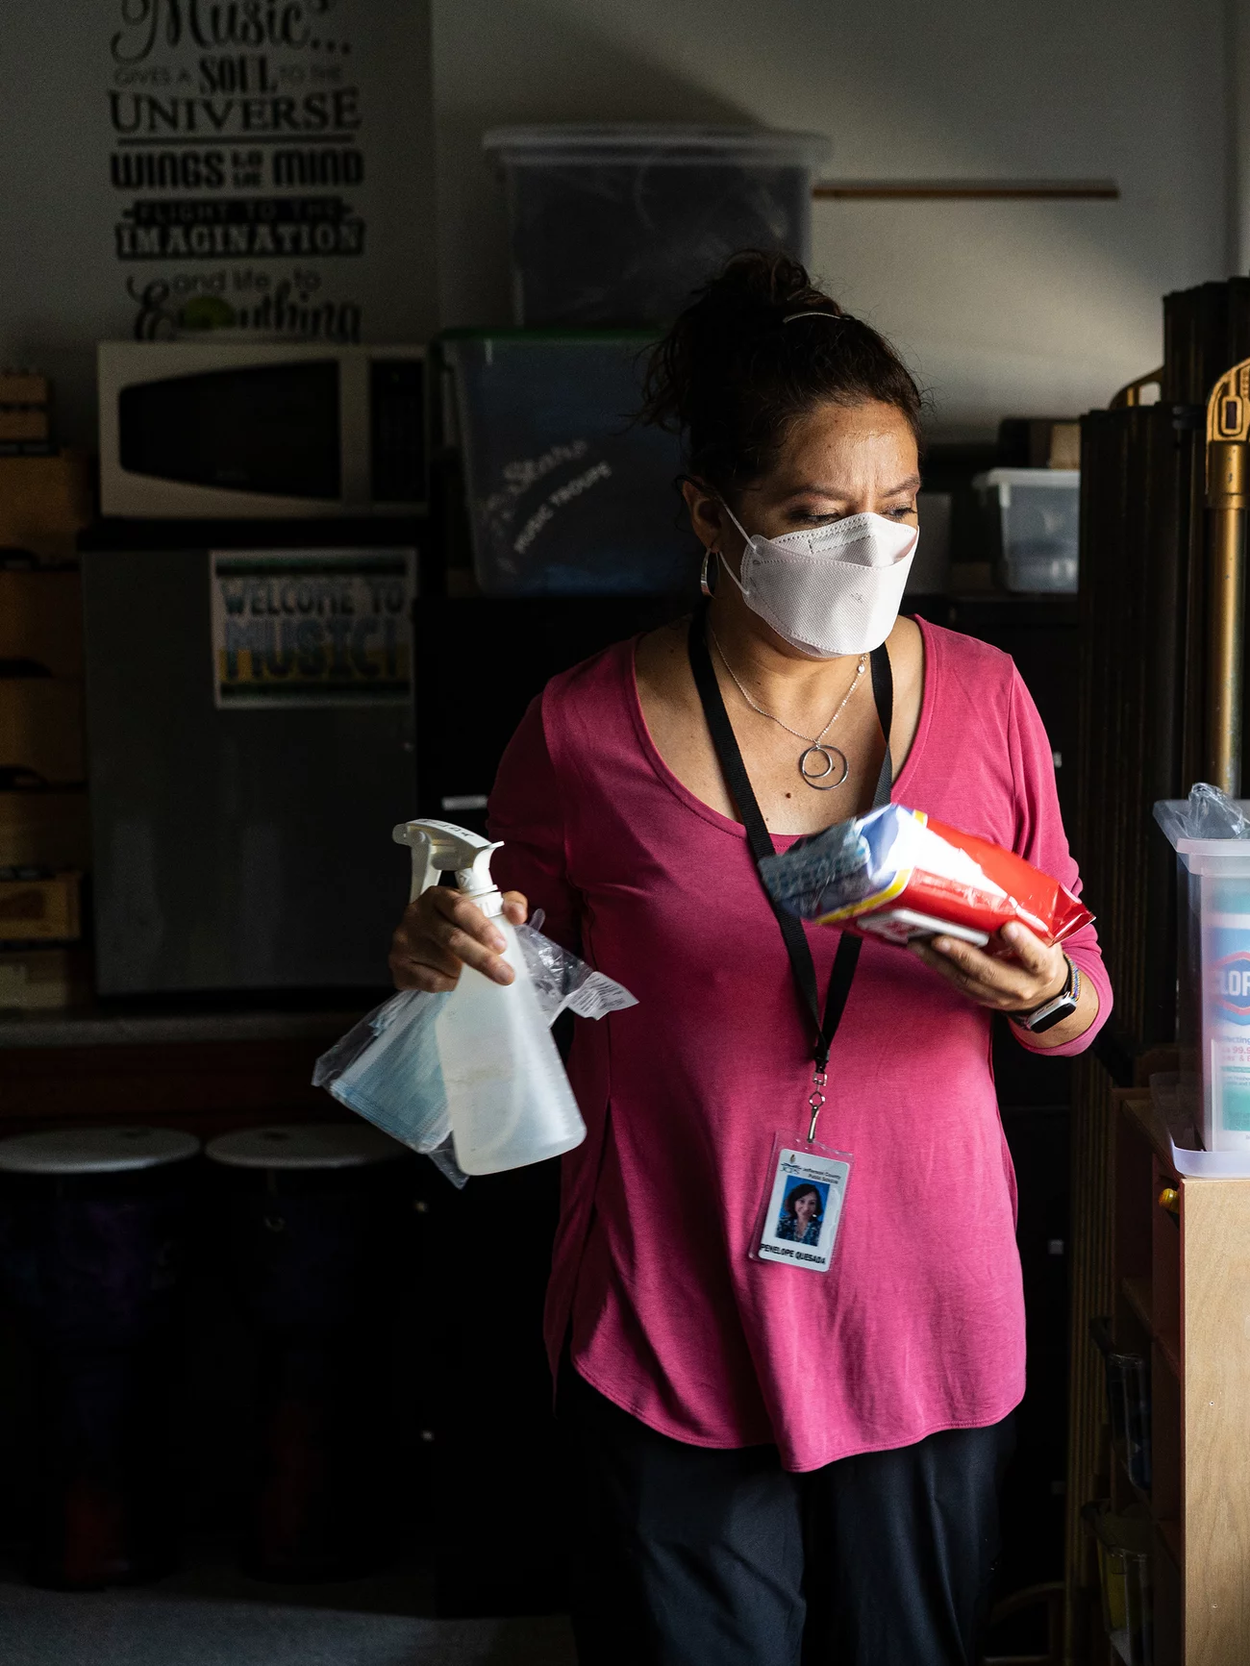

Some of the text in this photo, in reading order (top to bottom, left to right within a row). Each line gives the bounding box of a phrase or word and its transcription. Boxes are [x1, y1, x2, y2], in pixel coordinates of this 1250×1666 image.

[199, 54, 278, 95] SOUL
[108, 87, 362, 133] UNIVERSE
[138, 202, 230, 223] FLIGHT
[247, 202, 278, 222] TO
[119, 221, 362, 254] IMAGINATION
[219, 575, 405, 616] WELCOME TO
[224, 617, 397, 680] MUSIC!
[760, 1243, 826, 1265] PENELOPE QUESADA
